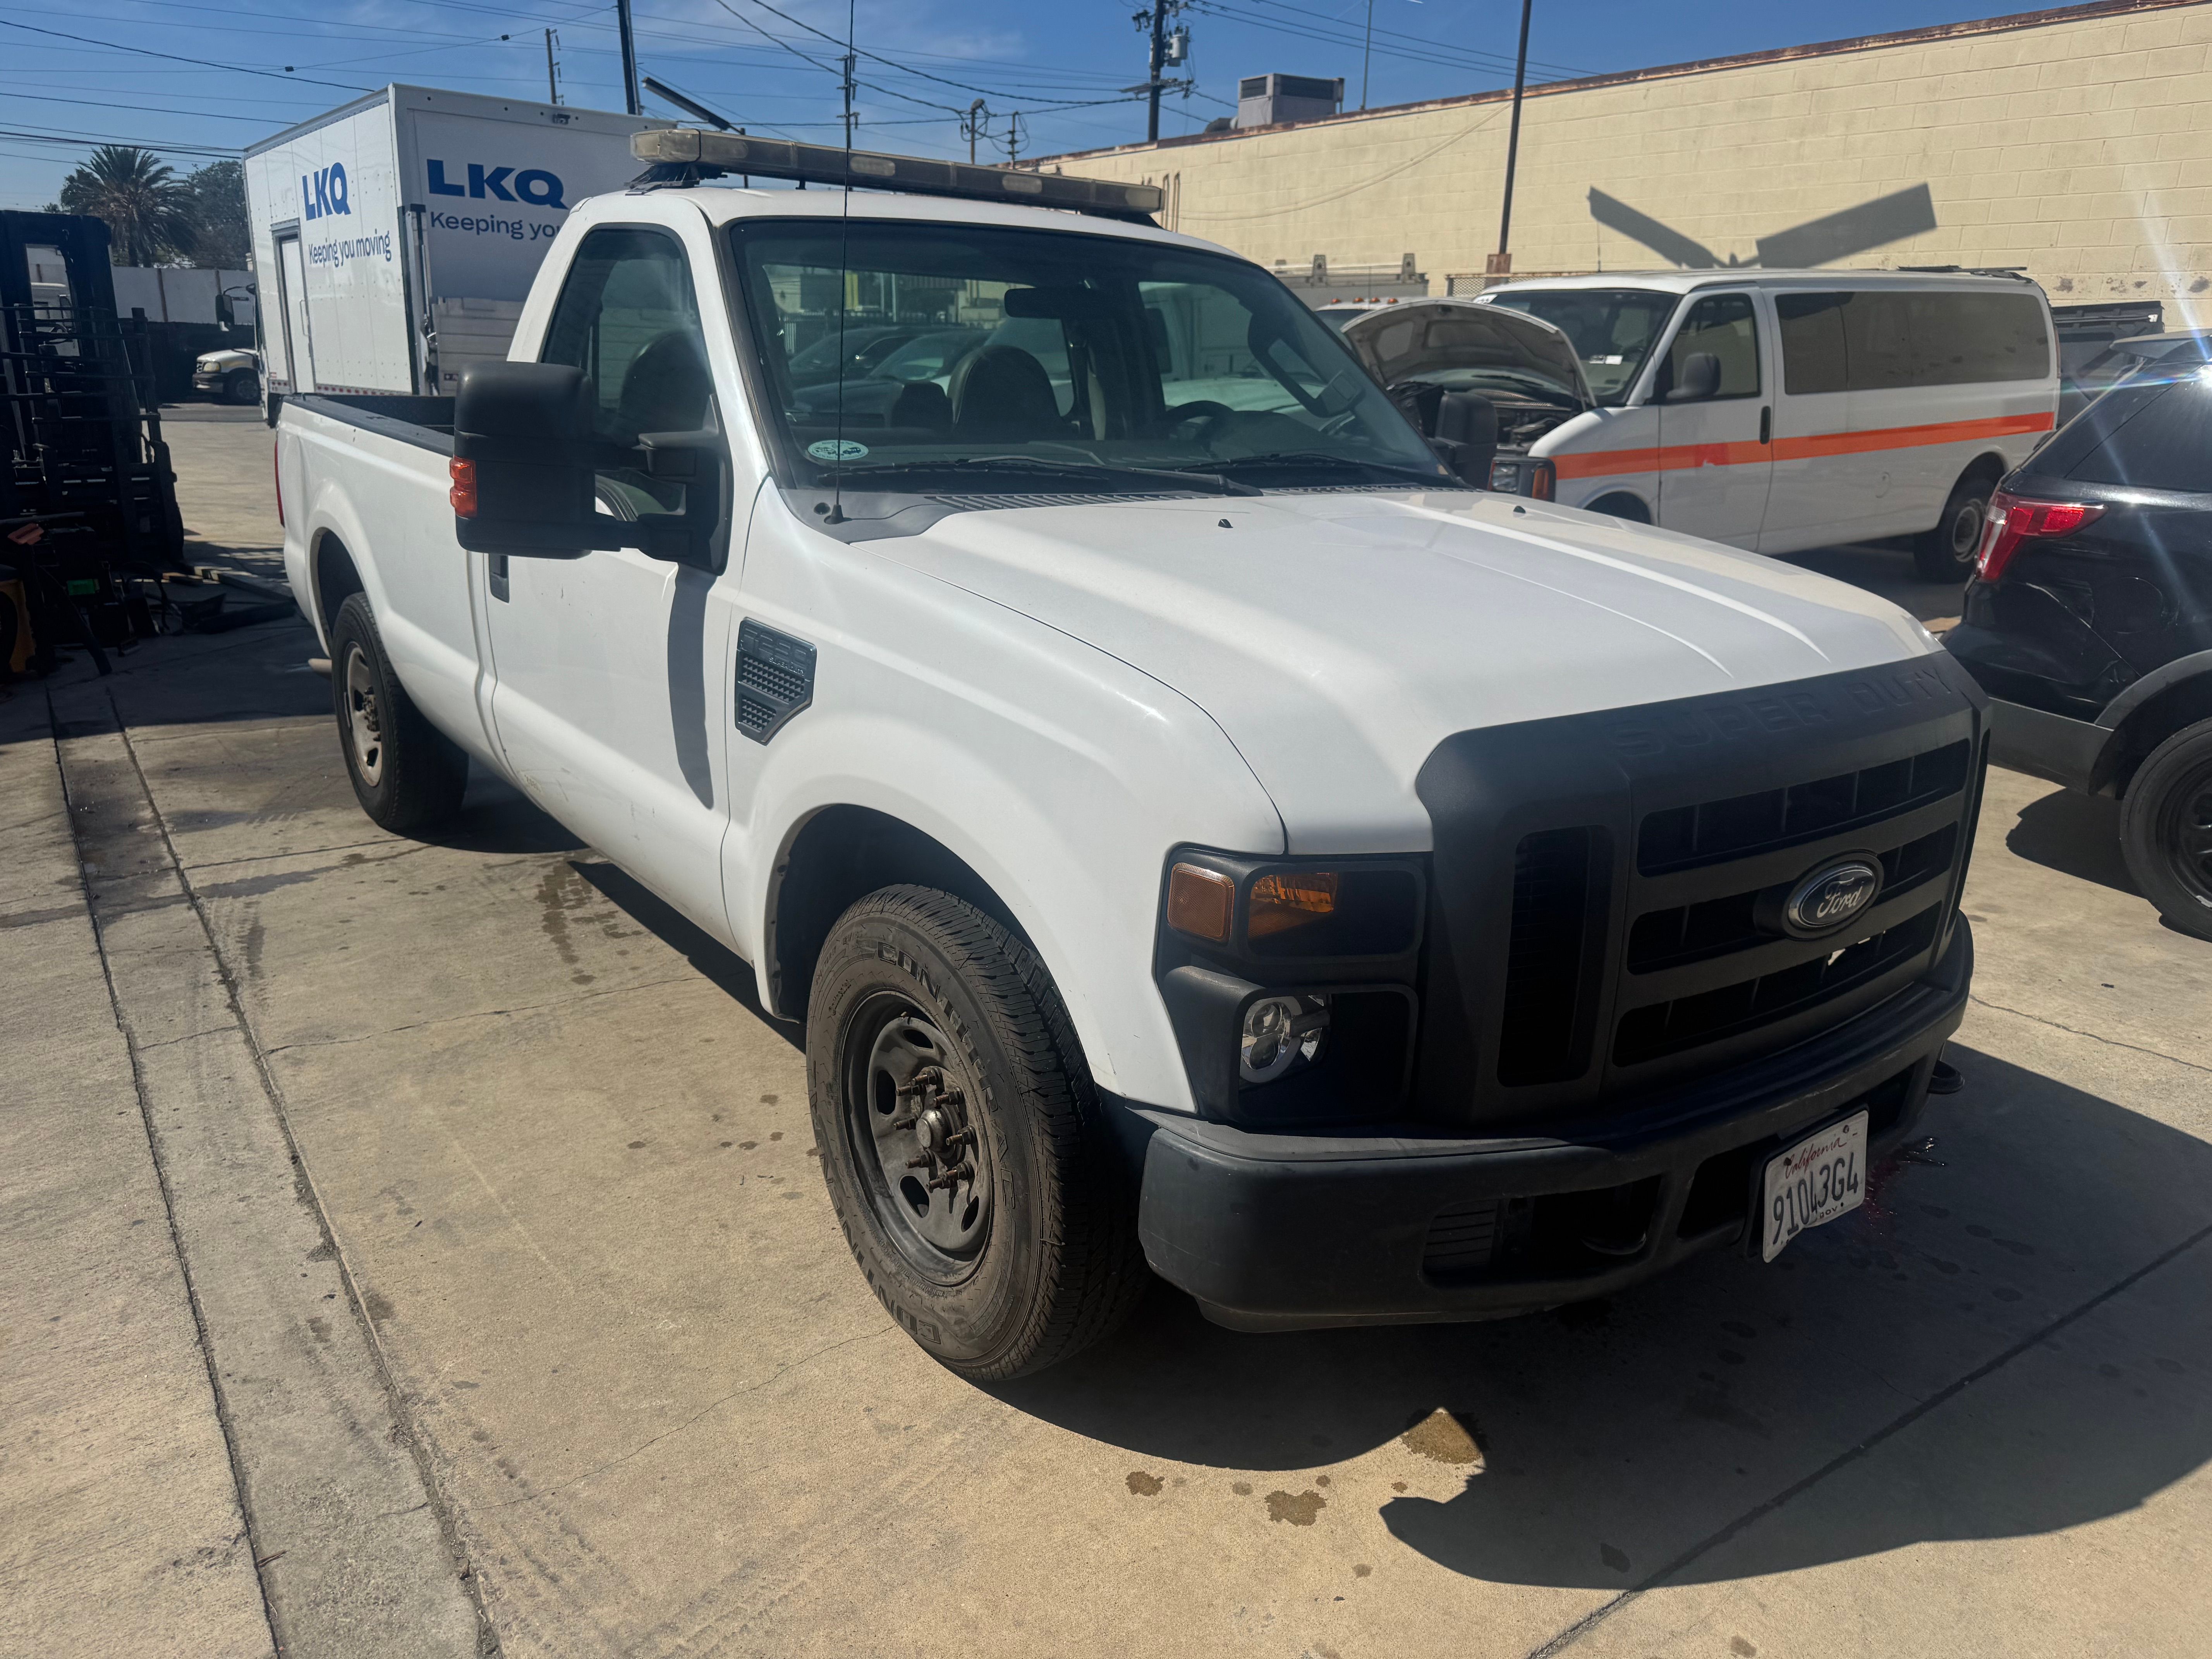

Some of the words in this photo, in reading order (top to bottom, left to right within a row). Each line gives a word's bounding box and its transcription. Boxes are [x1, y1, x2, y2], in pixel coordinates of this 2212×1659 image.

[302, 162, 351, 221] LKQ
[427, 159, 569, 210] LKQ
[309, 237, 339, 268] Keeping
[338, 239, 355, 266] you
[356, 228, 392, 262] moving
[430, 211, 524, 239] Keeping
[529, 223, 560, 240] yo
[1604, 693, 1834, 756] SUPER
[1843, 667, 1951, 716] DUTY
[1817, 877, 1863, 918] Ford
[1785, 1134, 1847, 1179] California
